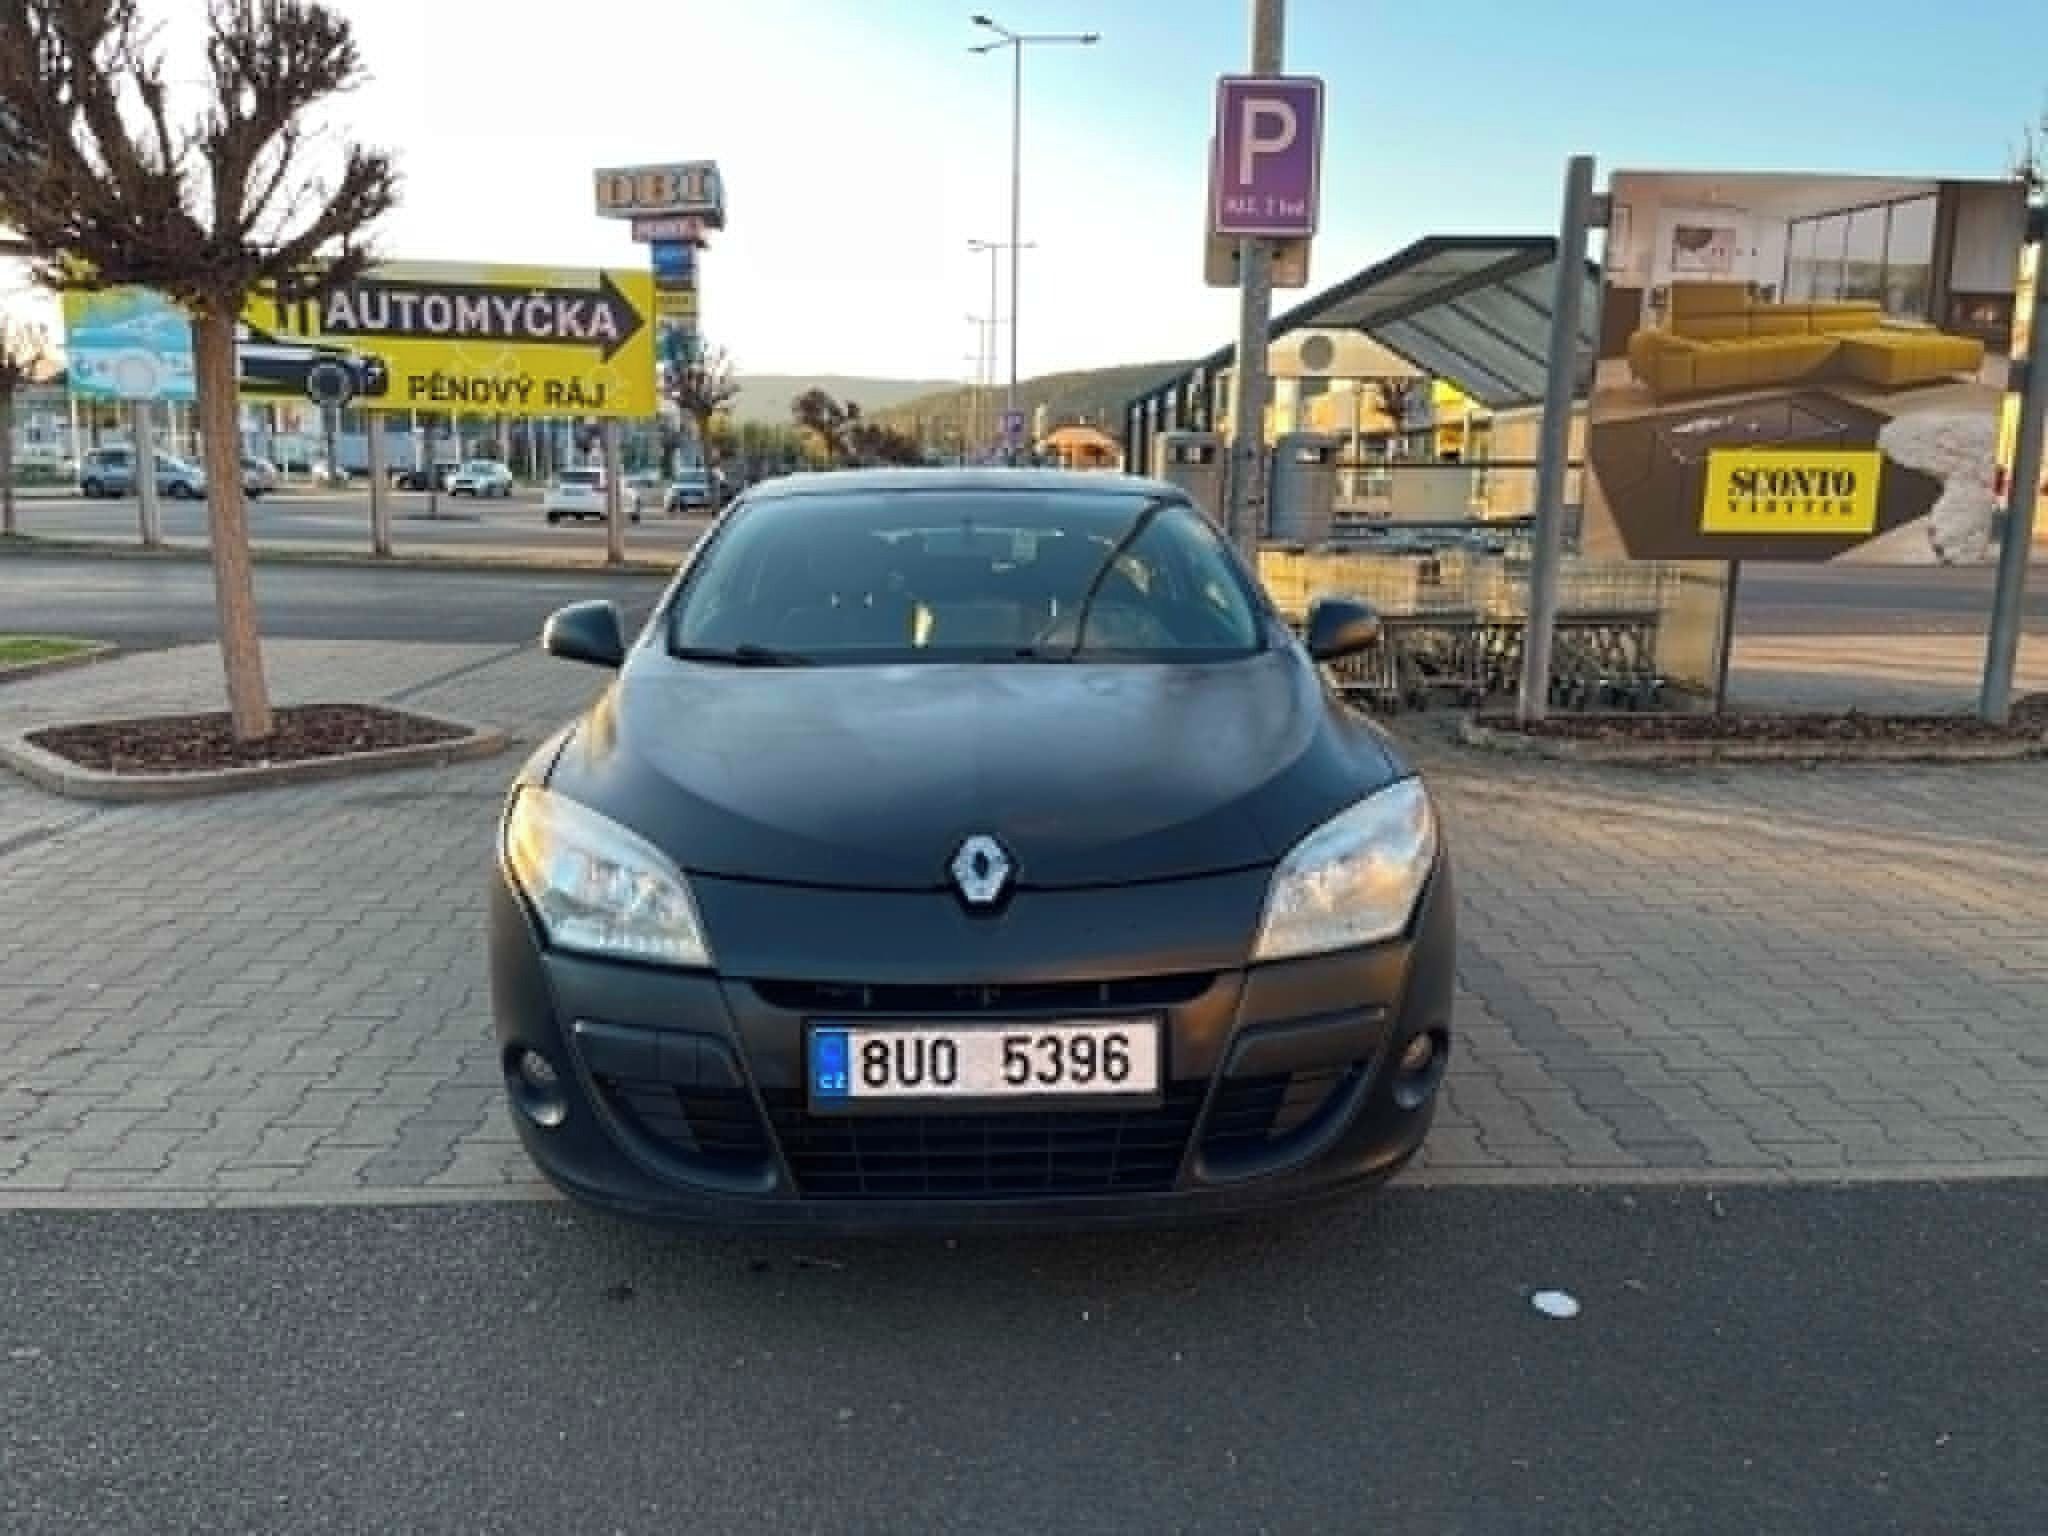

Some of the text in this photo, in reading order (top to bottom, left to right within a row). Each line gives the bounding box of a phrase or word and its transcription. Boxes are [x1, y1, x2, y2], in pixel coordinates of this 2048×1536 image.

[1239, 98, 1297, 185] P
[326, 289, 619, 338] AUTOMYČKA
[1729, 468, 1857, 497] SCONTO
[862, 1034, 1129, 1088] 8U0 5396
